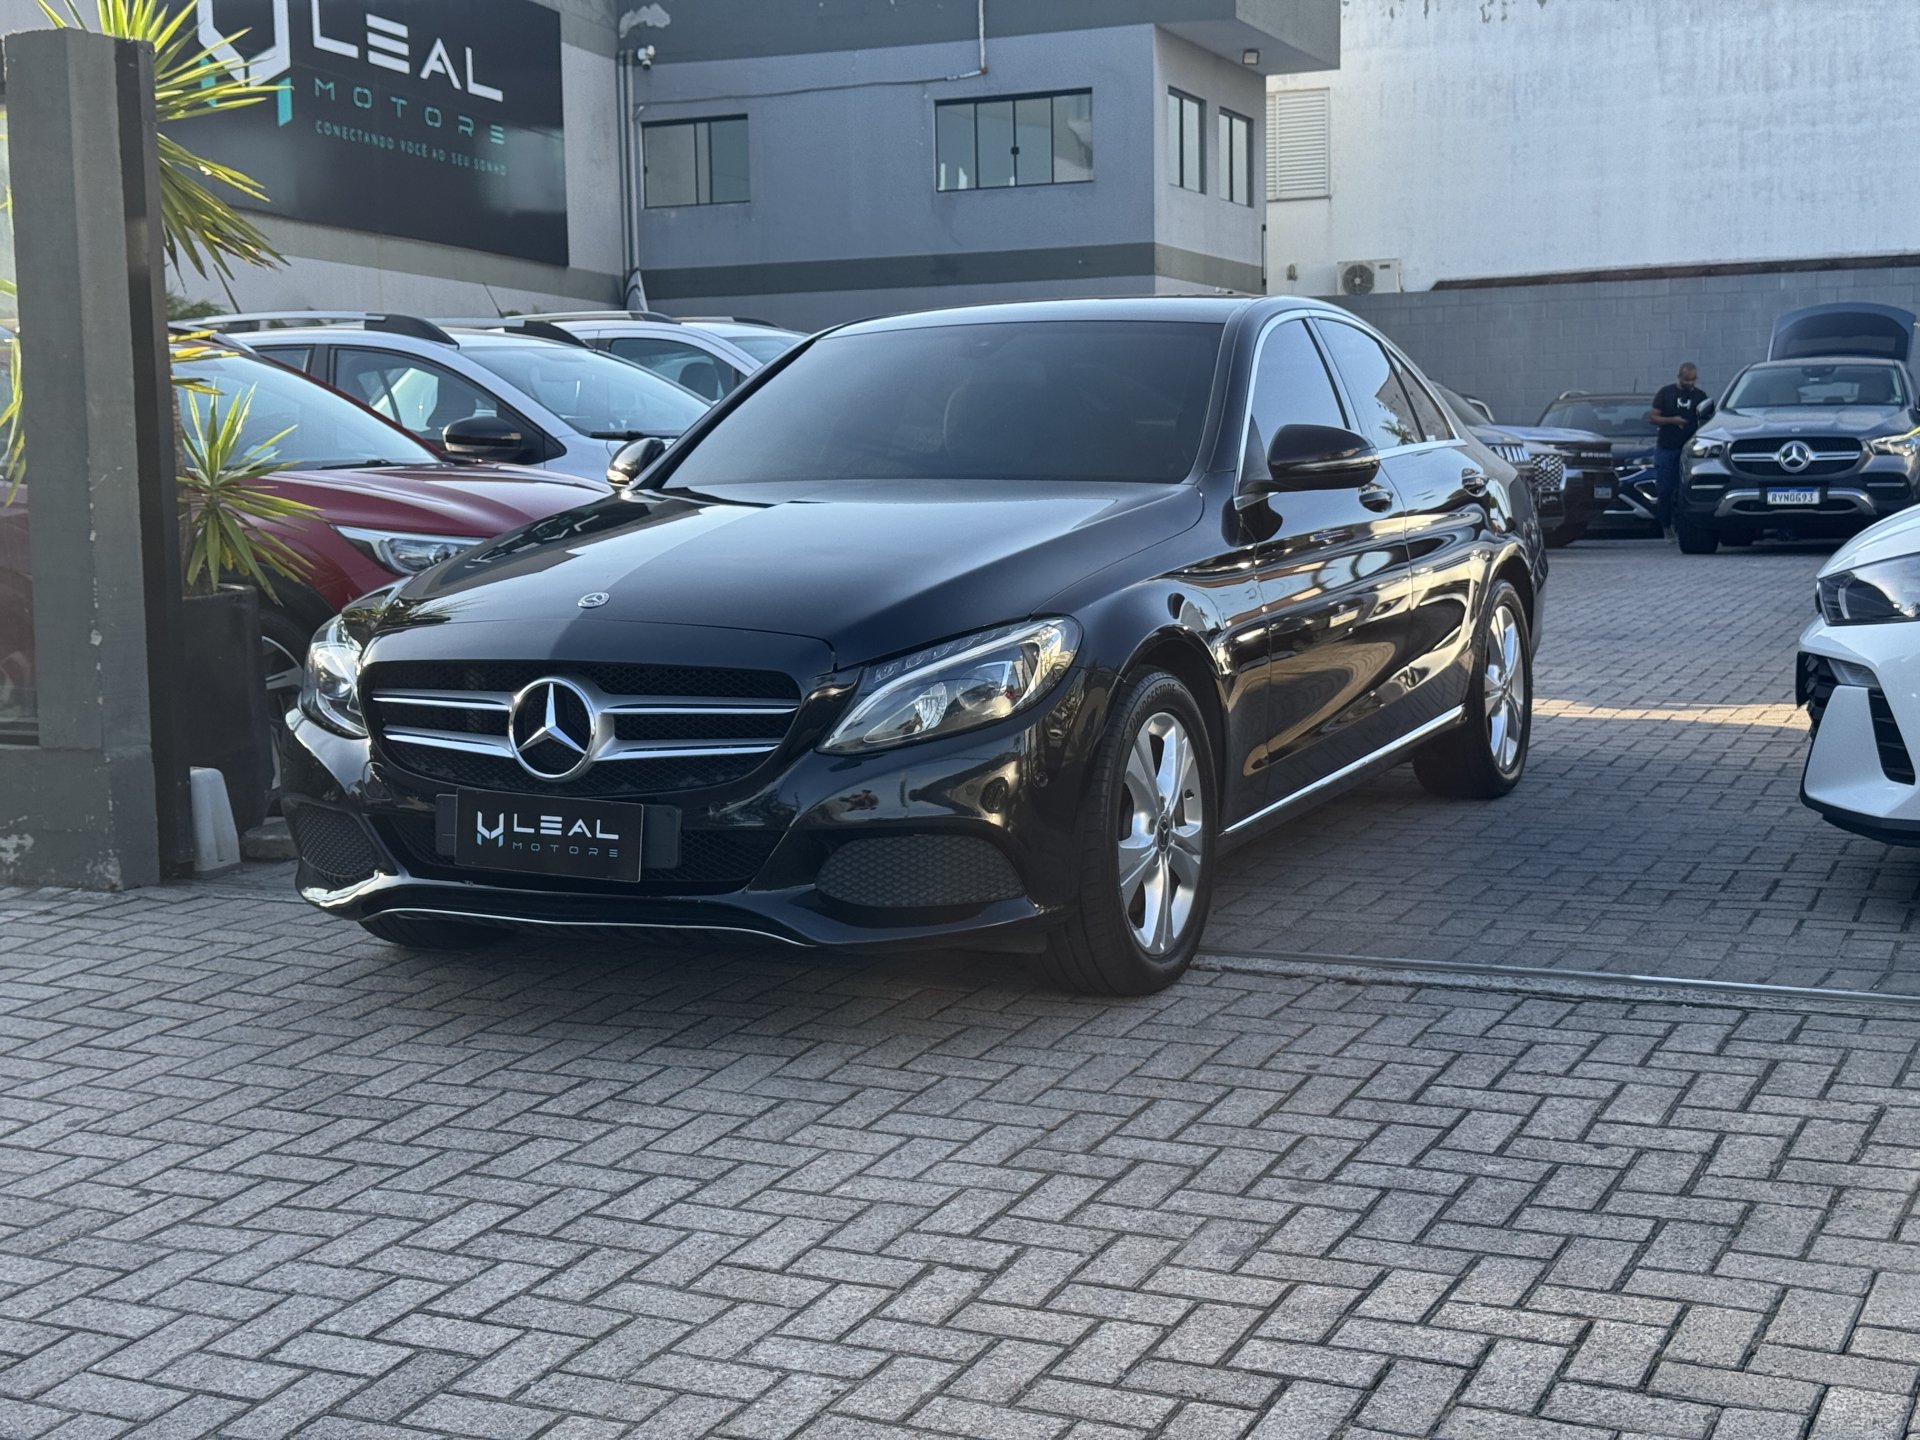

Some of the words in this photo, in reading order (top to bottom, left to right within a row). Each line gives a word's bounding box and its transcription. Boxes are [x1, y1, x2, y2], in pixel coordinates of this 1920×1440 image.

[311, 0, 503, 102] LEAL
[315, 120, 395, 150] CONECTANDO
[432, 148, 446, 161] AO
[451, 152, 469, 167] SEU
[473, 157, 506, 176] SONHO
[513, 813, 619, 840] LEAL
